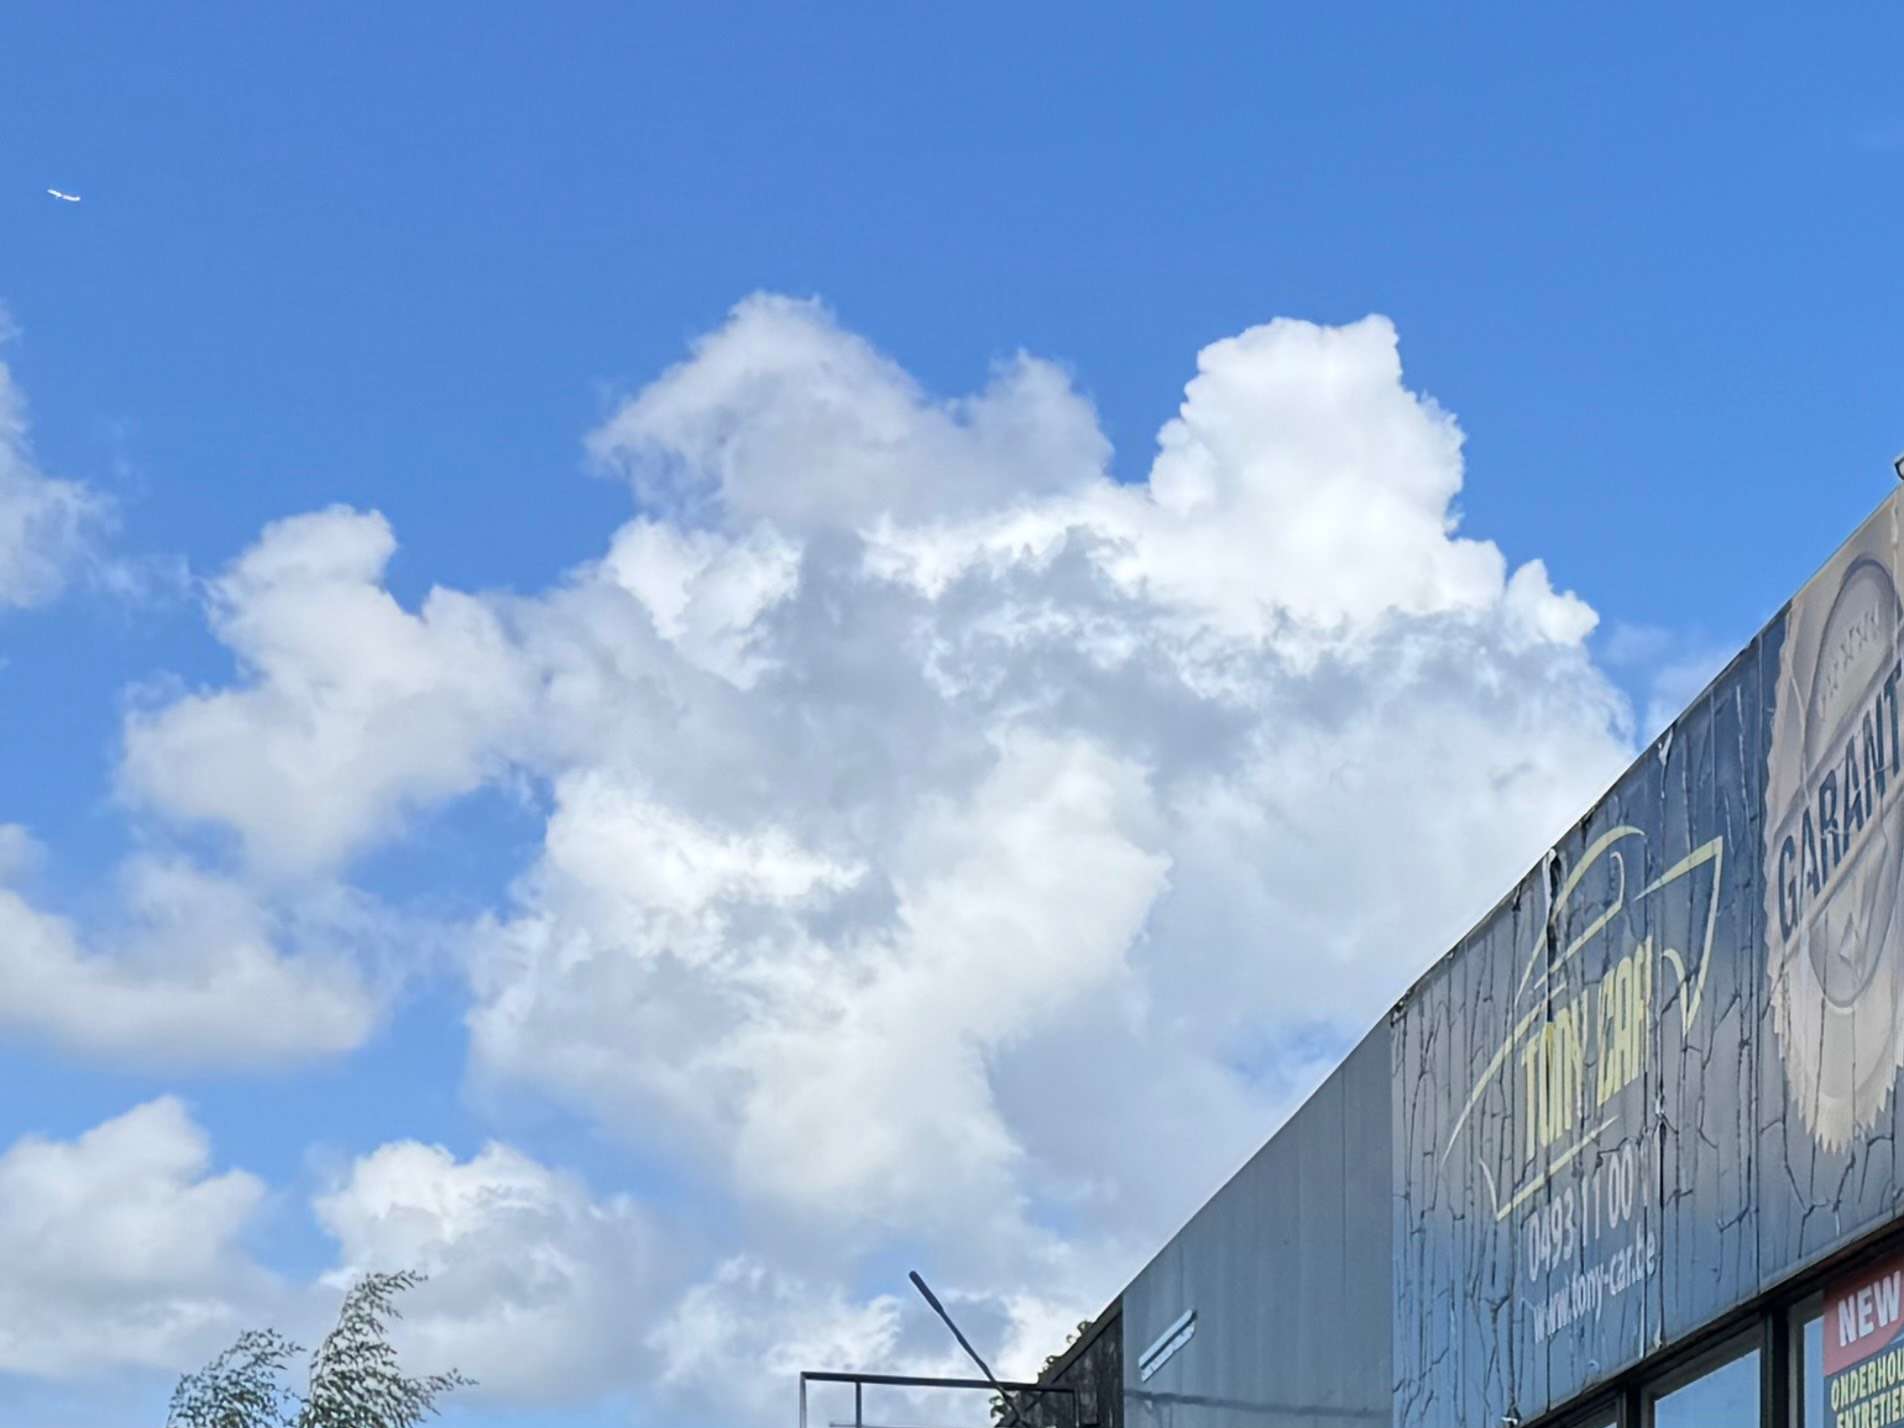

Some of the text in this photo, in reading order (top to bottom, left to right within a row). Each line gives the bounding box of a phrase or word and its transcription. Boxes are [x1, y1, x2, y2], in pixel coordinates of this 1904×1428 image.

[1521, 934, 1654, 1164] TONY CAR
[1838, 1270, 1901, 1347] NEW
